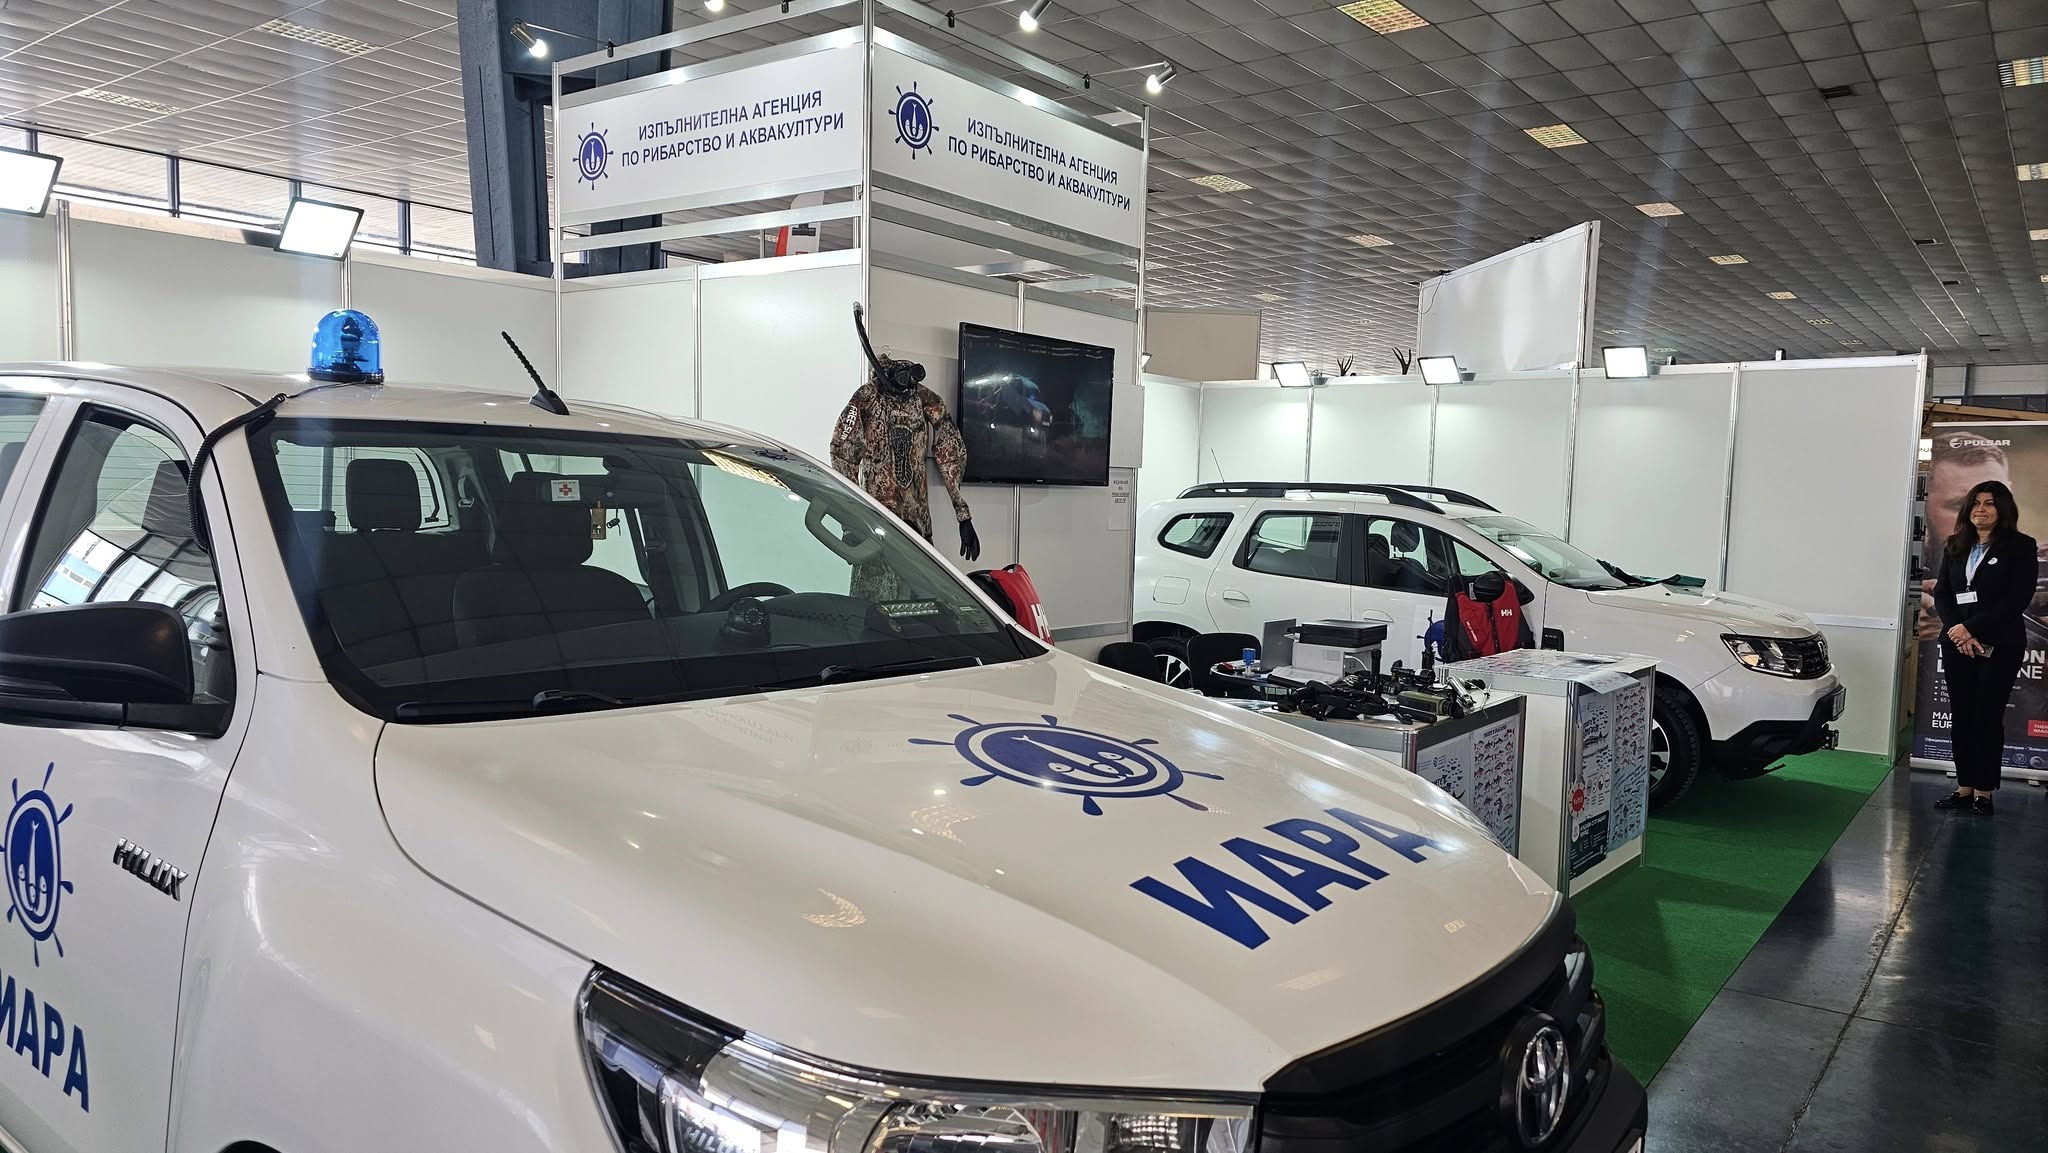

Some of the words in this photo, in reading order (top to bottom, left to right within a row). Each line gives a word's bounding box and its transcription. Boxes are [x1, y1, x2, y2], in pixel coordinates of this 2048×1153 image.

[622, 150, 640, 167] ПО
[643, 135, 722, 163] РИБАРСТВО
[726, 132, 735, 149] И
[739, 112, 844, 147] АКВАКУЛТУРИ
[639, 106, 748, 141] ИЗПЪЛНИТЕЛНА
[752, 90, 822, 120] АГЕНЦИЯ
[948, 135, 968, 156] ПО
[971, 143, 1044, 182] РИБАРСТВО
[1047, 169, 1055, 186] И
[1058, 174, 1131, 211] АКВАКУЛТУРИ
[968, 117, 1066, 167] ИЗПЪЛНИТЕЛНА
[1069, 155, 1118, 185] АГЕНЦИЯ
[1963, 439, 2011, 447] PULSAR
[112, 837, 189, 902] HILUX
[1129, 807, 1462, 950] ИАРА
